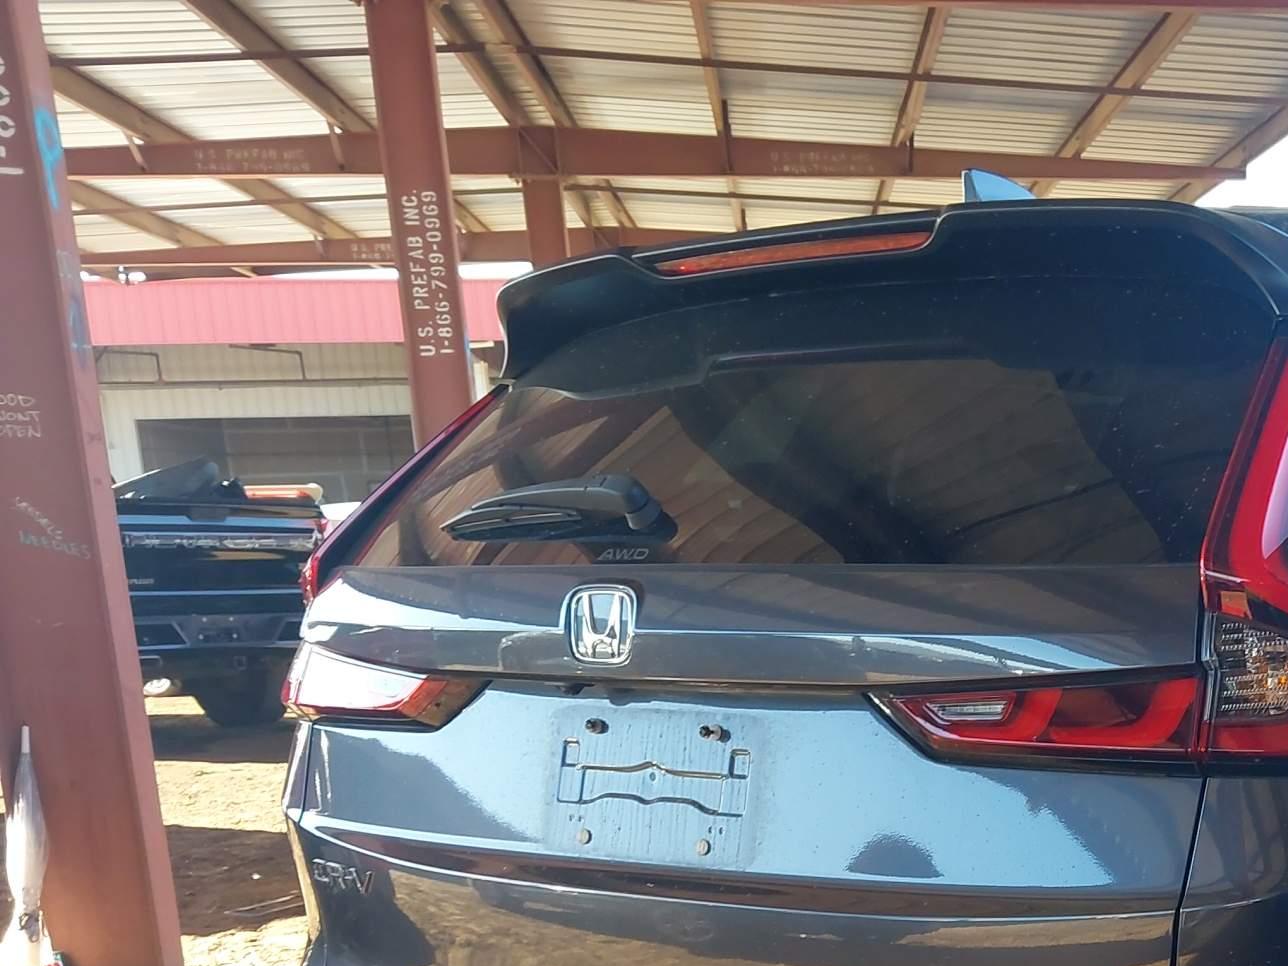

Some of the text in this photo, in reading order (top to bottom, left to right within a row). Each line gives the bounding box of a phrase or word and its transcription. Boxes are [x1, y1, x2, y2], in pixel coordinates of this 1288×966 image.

[401, 189, 437, 357] U.S. PREFAB INC.
[420, 191, 455, 354] 1-866-799-0969
[596, 547, 649, 561] AWD
[311, 858, 376, 895] CR-V
